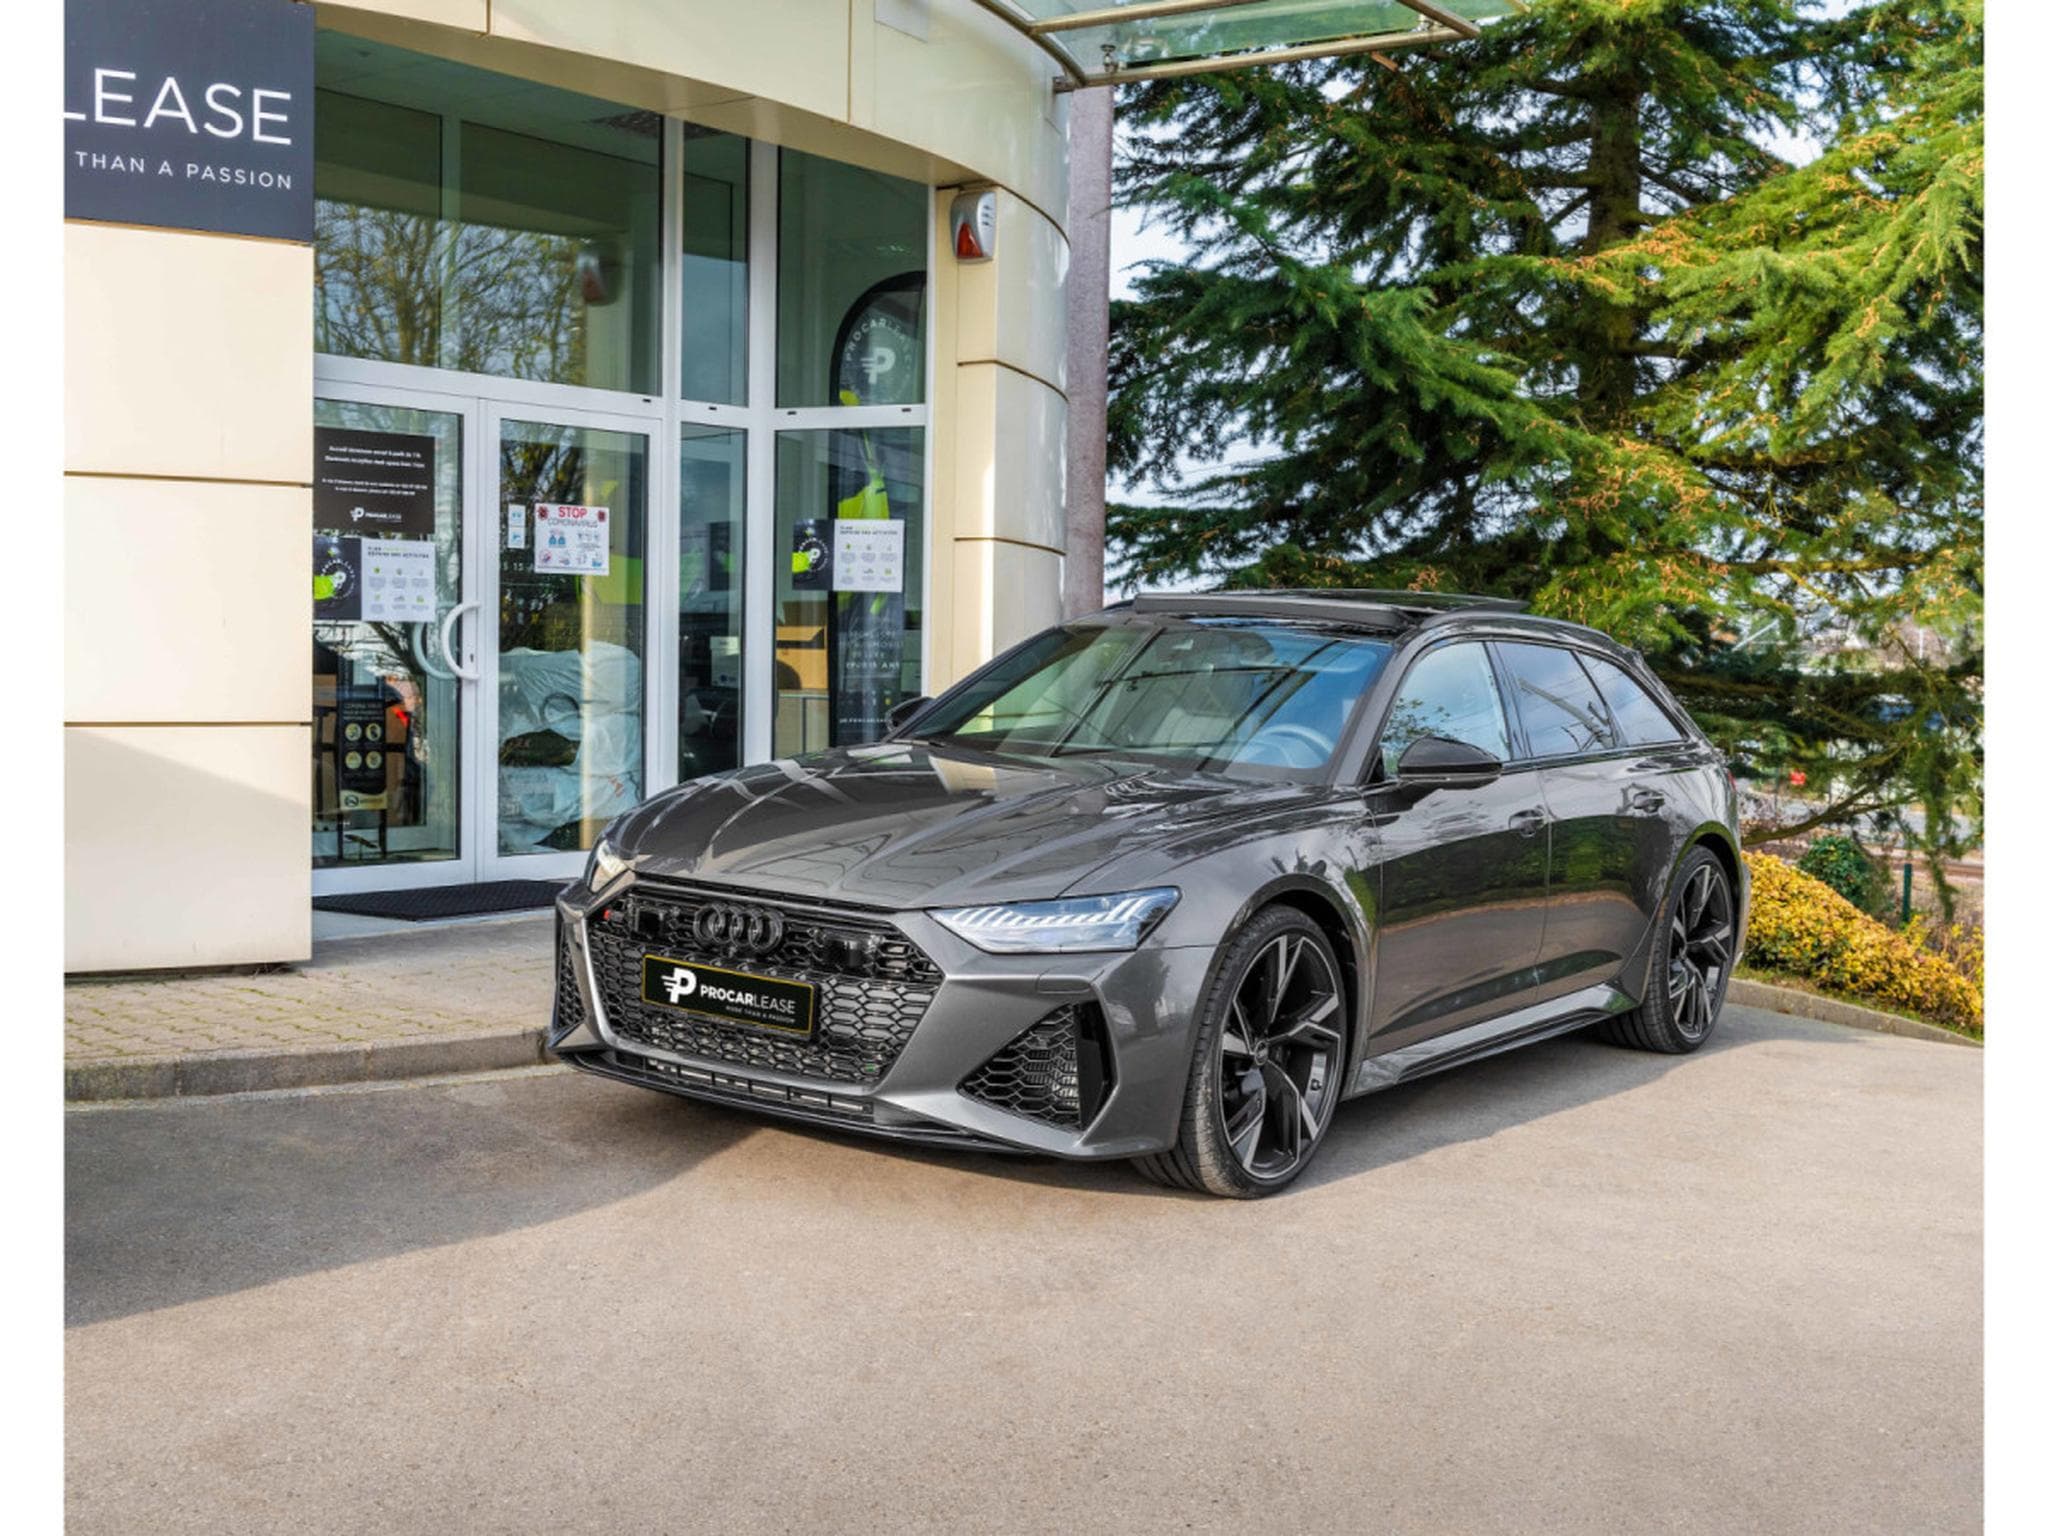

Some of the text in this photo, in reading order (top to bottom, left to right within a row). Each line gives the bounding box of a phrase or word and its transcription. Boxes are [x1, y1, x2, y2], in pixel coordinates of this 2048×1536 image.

[75, 151, 292, 190] THAN A PASSION
[558, 505, 587, 518] STOP
[699, 985, 797, 1015] PROCARLEASE
